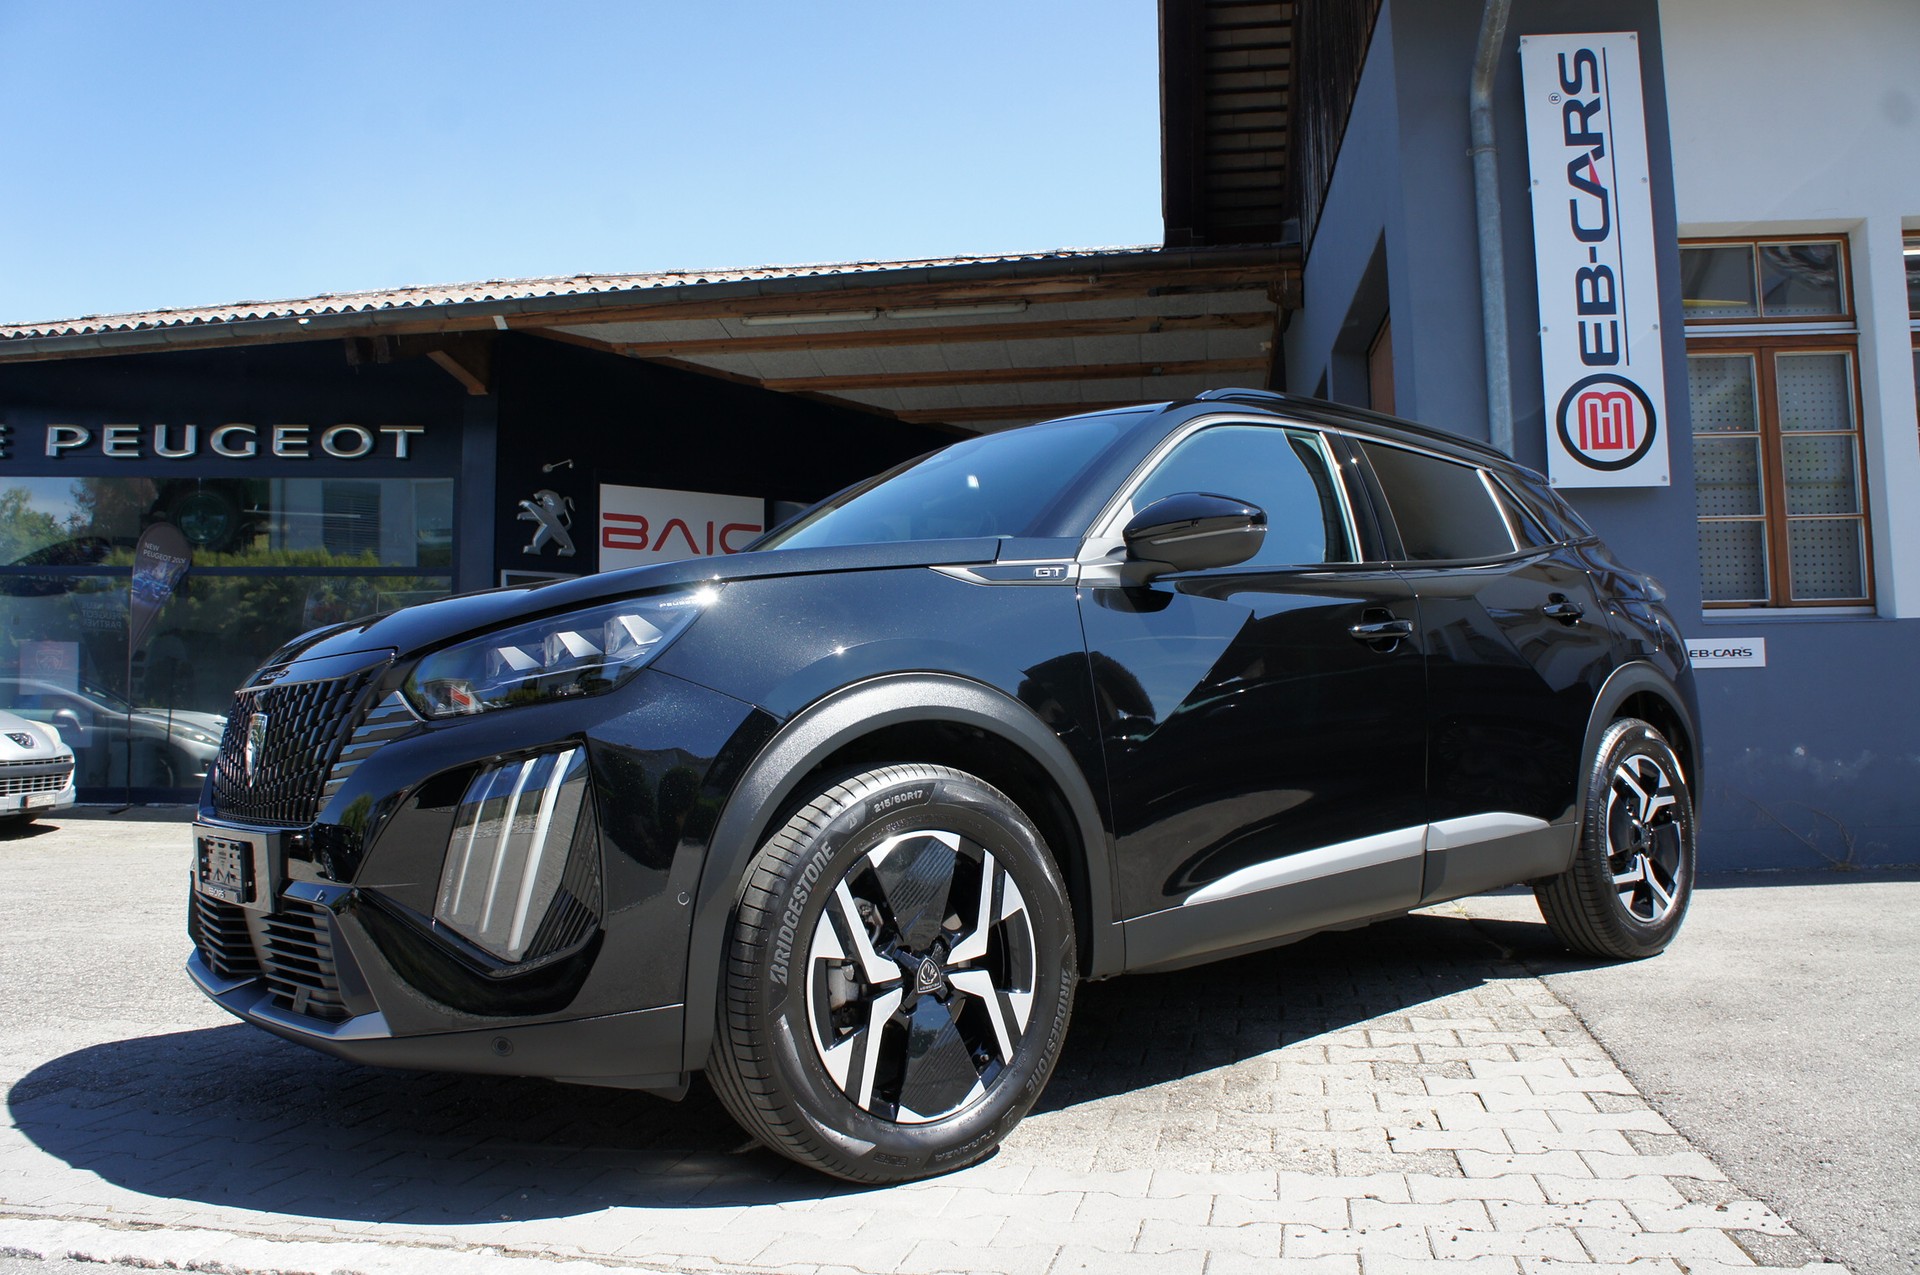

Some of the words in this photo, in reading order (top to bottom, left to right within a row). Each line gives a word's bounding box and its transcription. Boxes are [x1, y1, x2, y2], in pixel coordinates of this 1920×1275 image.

[1557, 47, 1620, 366] EB-CARS
[45, 423, 425, 459] PEUGEOT
[144, 542, 160, 552] NEW
[602, 512, 762, 555] BAIC
[143, 550, 171, 561] PEUGEOT
[1035, 567, 1064, 577] GT
[1689, 647, 1753, 658] EB-CARS
[873, 789, 924, 814] 215/60R17
[768, 840, 835, 986] BRIDGESTONE
[1026, 967, 1072, 1095] BRIDGESTONE
[934, 1128, 996, 1163] TURANZA
